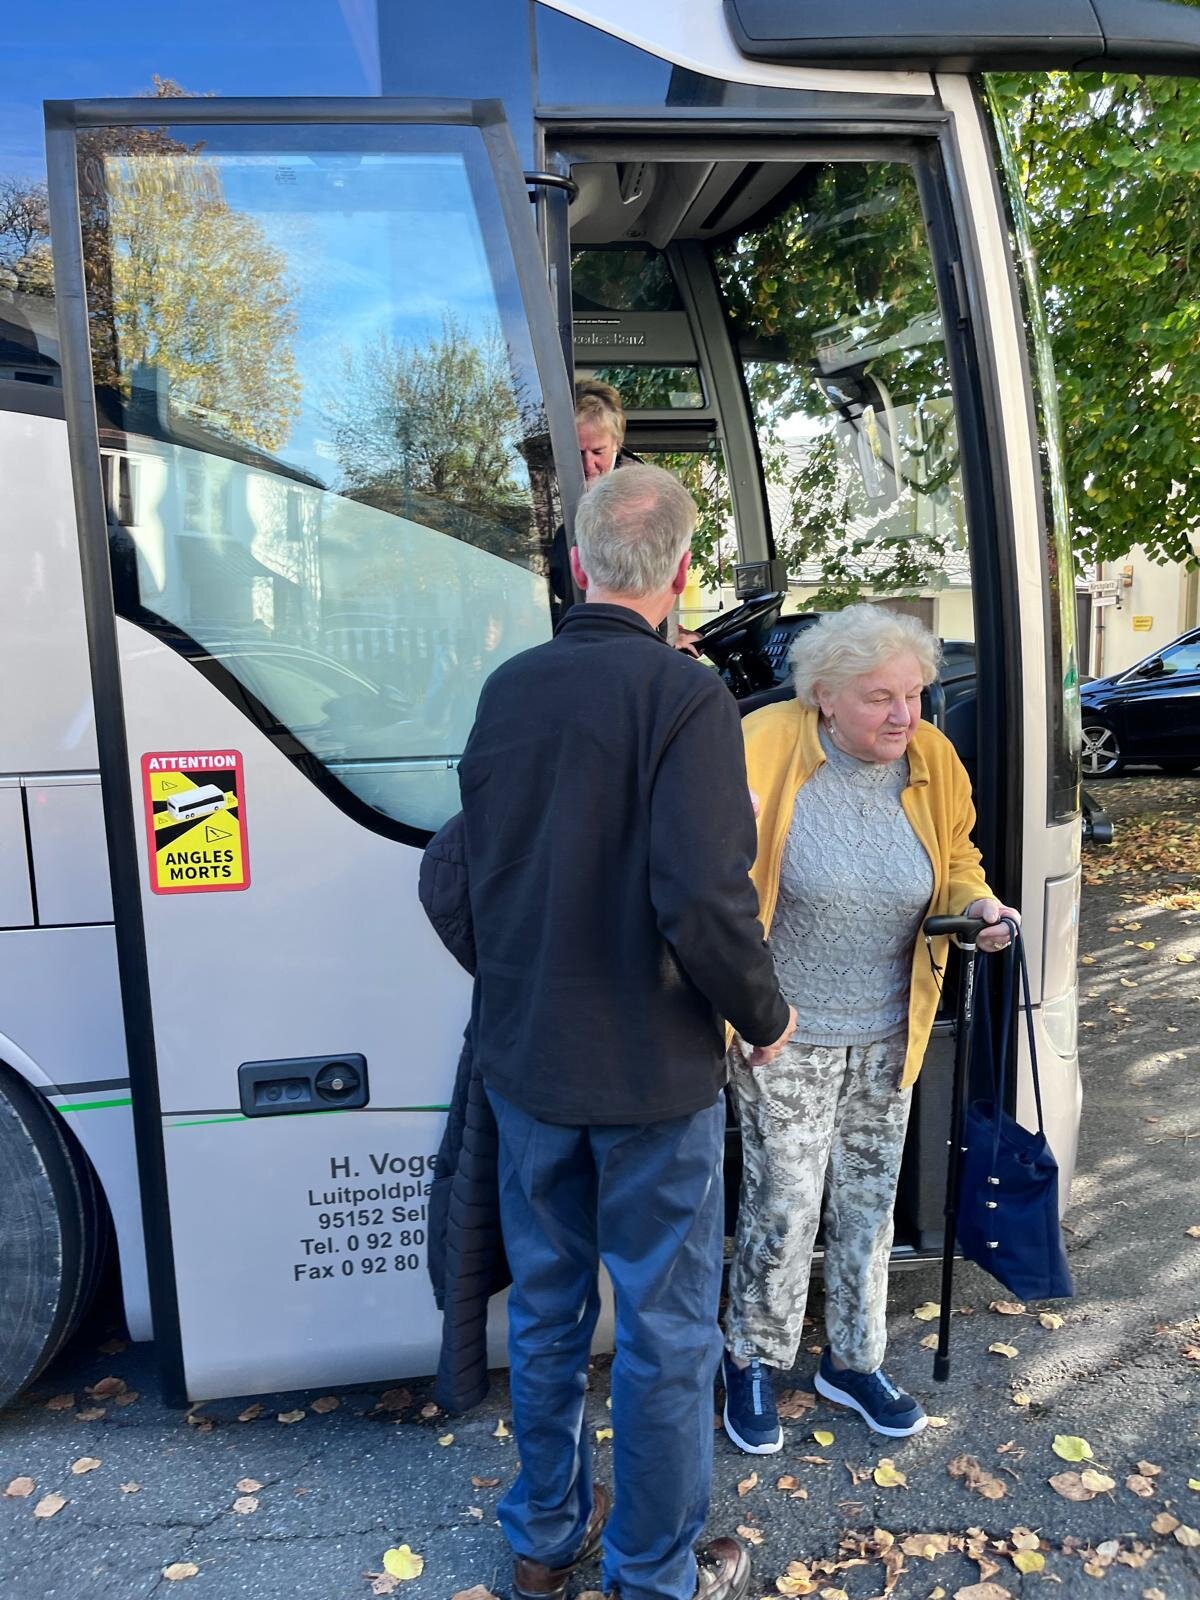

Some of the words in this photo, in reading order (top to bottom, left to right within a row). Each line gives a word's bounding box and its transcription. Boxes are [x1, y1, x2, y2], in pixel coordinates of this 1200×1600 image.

[149, 755, 236, 769] ATTENTION
[165, 850, 234, 865] ANGLES
[170, 865, 232, 880] MORTS
[330, 1156, 359, 1179] H.
[369, 1153, 438, 1178] Voge
[308, 1180, 432, 1206] Luitpoldpla
[318, 1208, 384, 1230] 95152
[391, 1204, 426, 1223] Sel
[300, 1237, 340, 1255] Tel.
[347, 1235, 359, 1251] 0
[366, 1232, 393, 1250] 92
[400, 1229, 425, 1246] 80
[294, 1264, 335, 1281] Fax
[341, 1260, 354, 1276] 0
[361, 1257, 387, 1274] 92
[394, 1254, 419, 1271] 80
